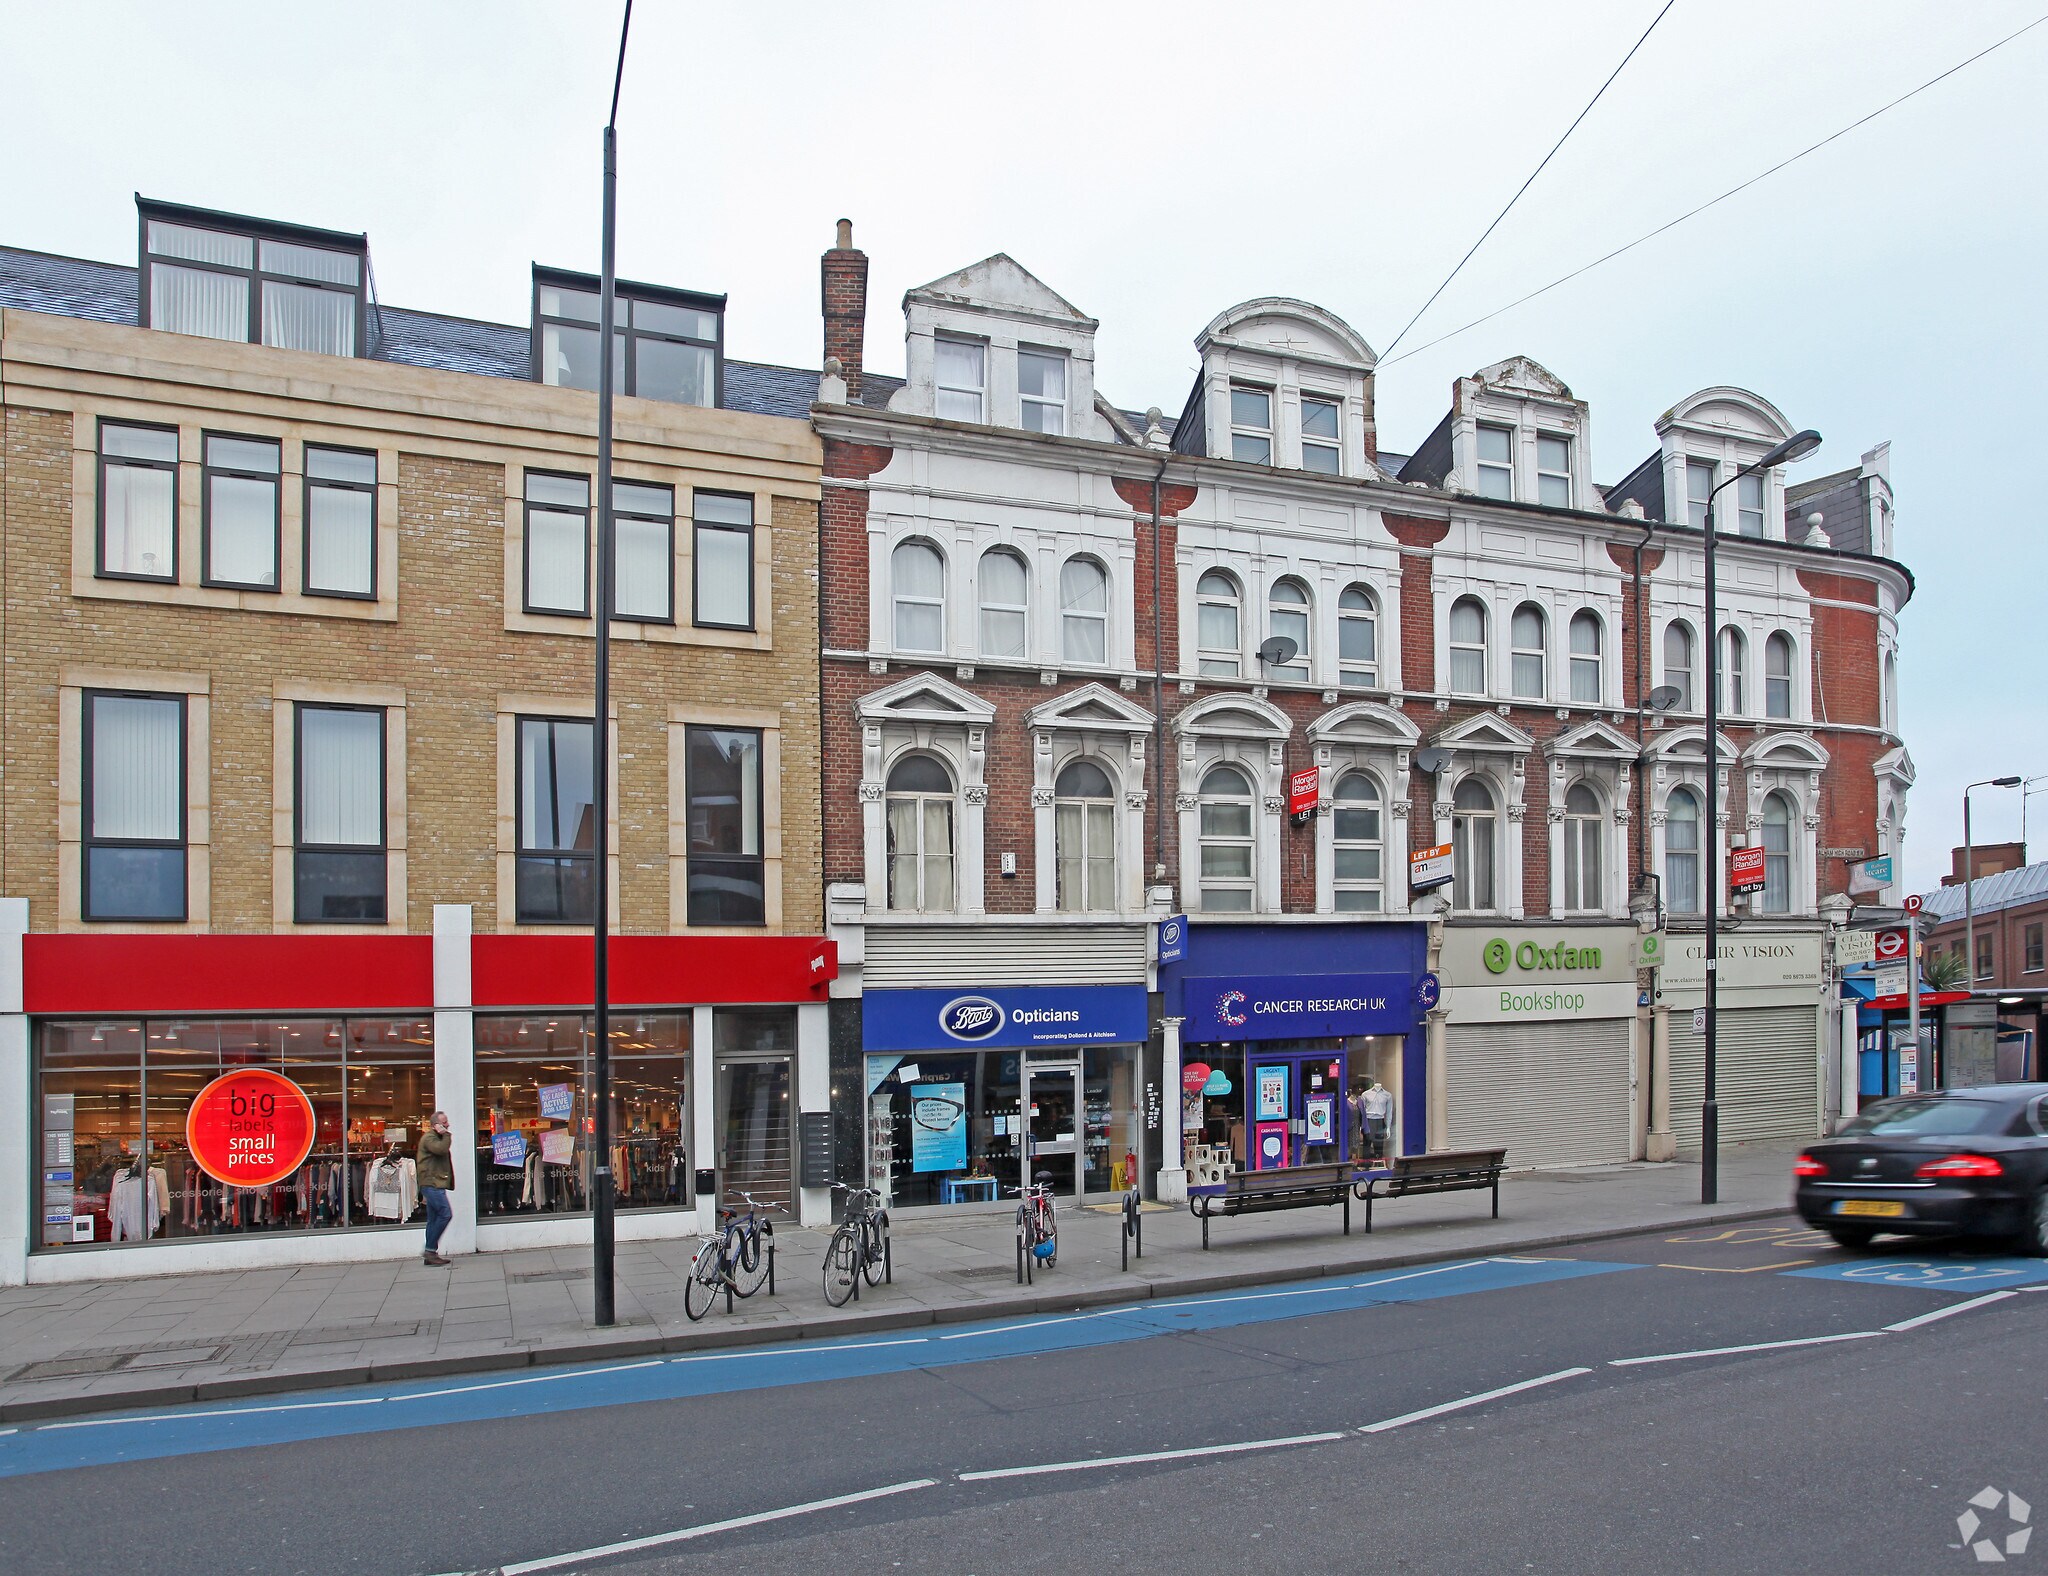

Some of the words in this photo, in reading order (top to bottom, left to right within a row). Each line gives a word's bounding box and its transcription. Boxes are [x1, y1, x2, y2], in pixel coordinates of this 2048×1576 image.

[1294, 774, 1316, 786] Morgan
[1294, 780, 1316, 794] Randall
[1298, 809, 1311, 820] LET
[1413, 851, 1428, 860] LET
[1430, 847, 1440, 857] BY
[1735, 852, 1760, 862] Morgan
[1414, 862, 1428, 873] am
[1735, 858, 1760, 869] Randall
[1908, 896, 1919, 910] D
[1839, 940, 1873, 951] VISIO
[1515, 940, 1602, 970] Oxfam
[1686, 946, 1734, 959] CLIR
[1743, 945, 1795, 958] VISION
[1639, 956, 1661, 965] Oxfam
[1253, 1000, 1303, 1014] CANCER
[1308, 998, 1367, 1012] RESEARCH
[1370, 997, 1386, 1010] UK
[1500, 990, 1585, 1013] Bookshop
[951, 1005, 994, 1030] Boots
[1012, 1008, 1079, 1025] Opticians
[231, 1089, 275, 1118] big
[543, 1097, 569, 1109] ACTIVE
[556, 1104, 570, 1112] LESS
[229, 1119, 275, 1132] labels
[229, 1133, 275, 1150] small
[495, 1144, 522, 1155] LUGGAGE
[508, 1150, 523, 1158] LESS
[228, 1149, 275, 1168] prices
[551, 1169, 580, 1178] shoes
[646, 1164, 665, 1173] kids
[168, 1187, 228, 1199] ccessorie
